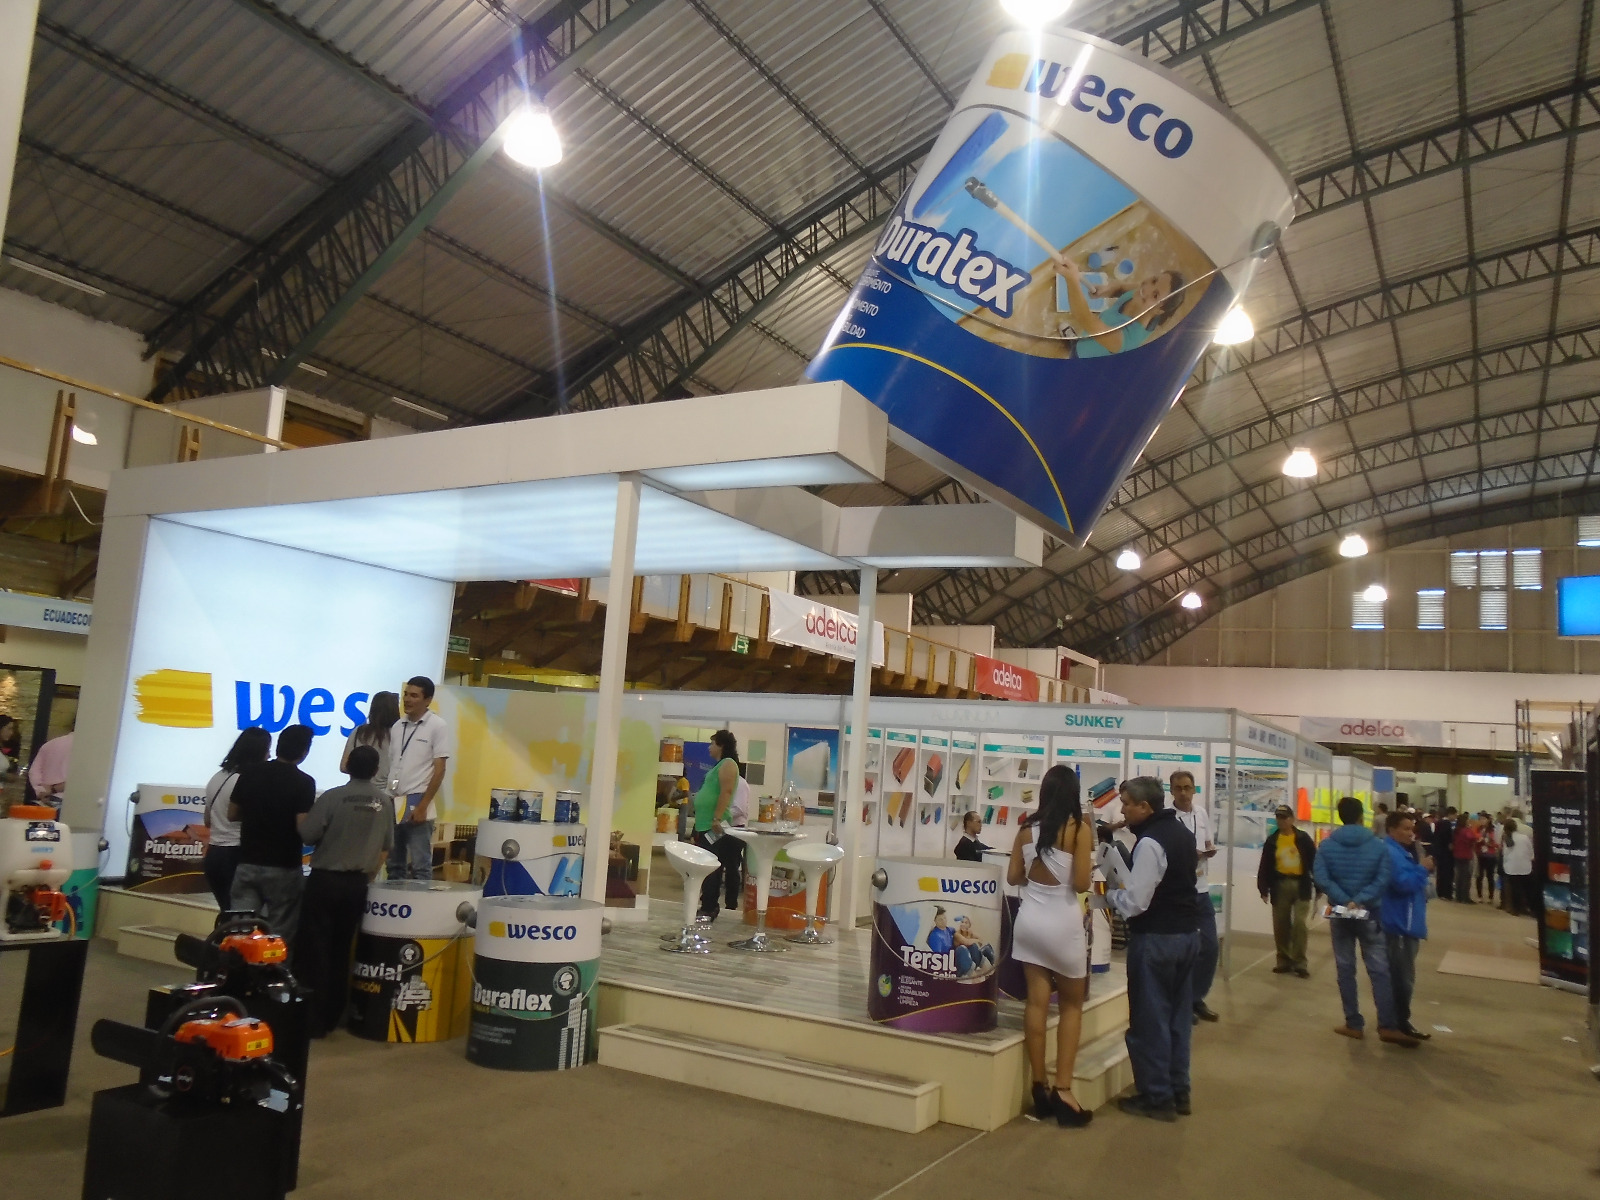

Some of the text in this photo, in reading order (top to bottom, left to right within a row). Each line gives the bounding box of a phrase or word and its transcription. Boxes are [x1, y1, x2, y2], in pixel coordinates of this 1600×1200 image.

[1024, 58, 1194, 159] wesco
[874, 215, 1028, 314] Duratex
[805, 607, 857, 646] adelca
[992, 663, 1022, 691] adelca
[1064, 714, 1124, 729] SUNKEY
[1340, 719, 1405, 738] adelca
[144, 839, 204, 855] Pinternit
[940, 877, 997, 894] wesco
[507, 923, 577, 941] wesco
[900, 944, 958, 972] Tersil
[355, 963, 403, 982] ravial
[473, 982, 553, 1012] Duraflex
